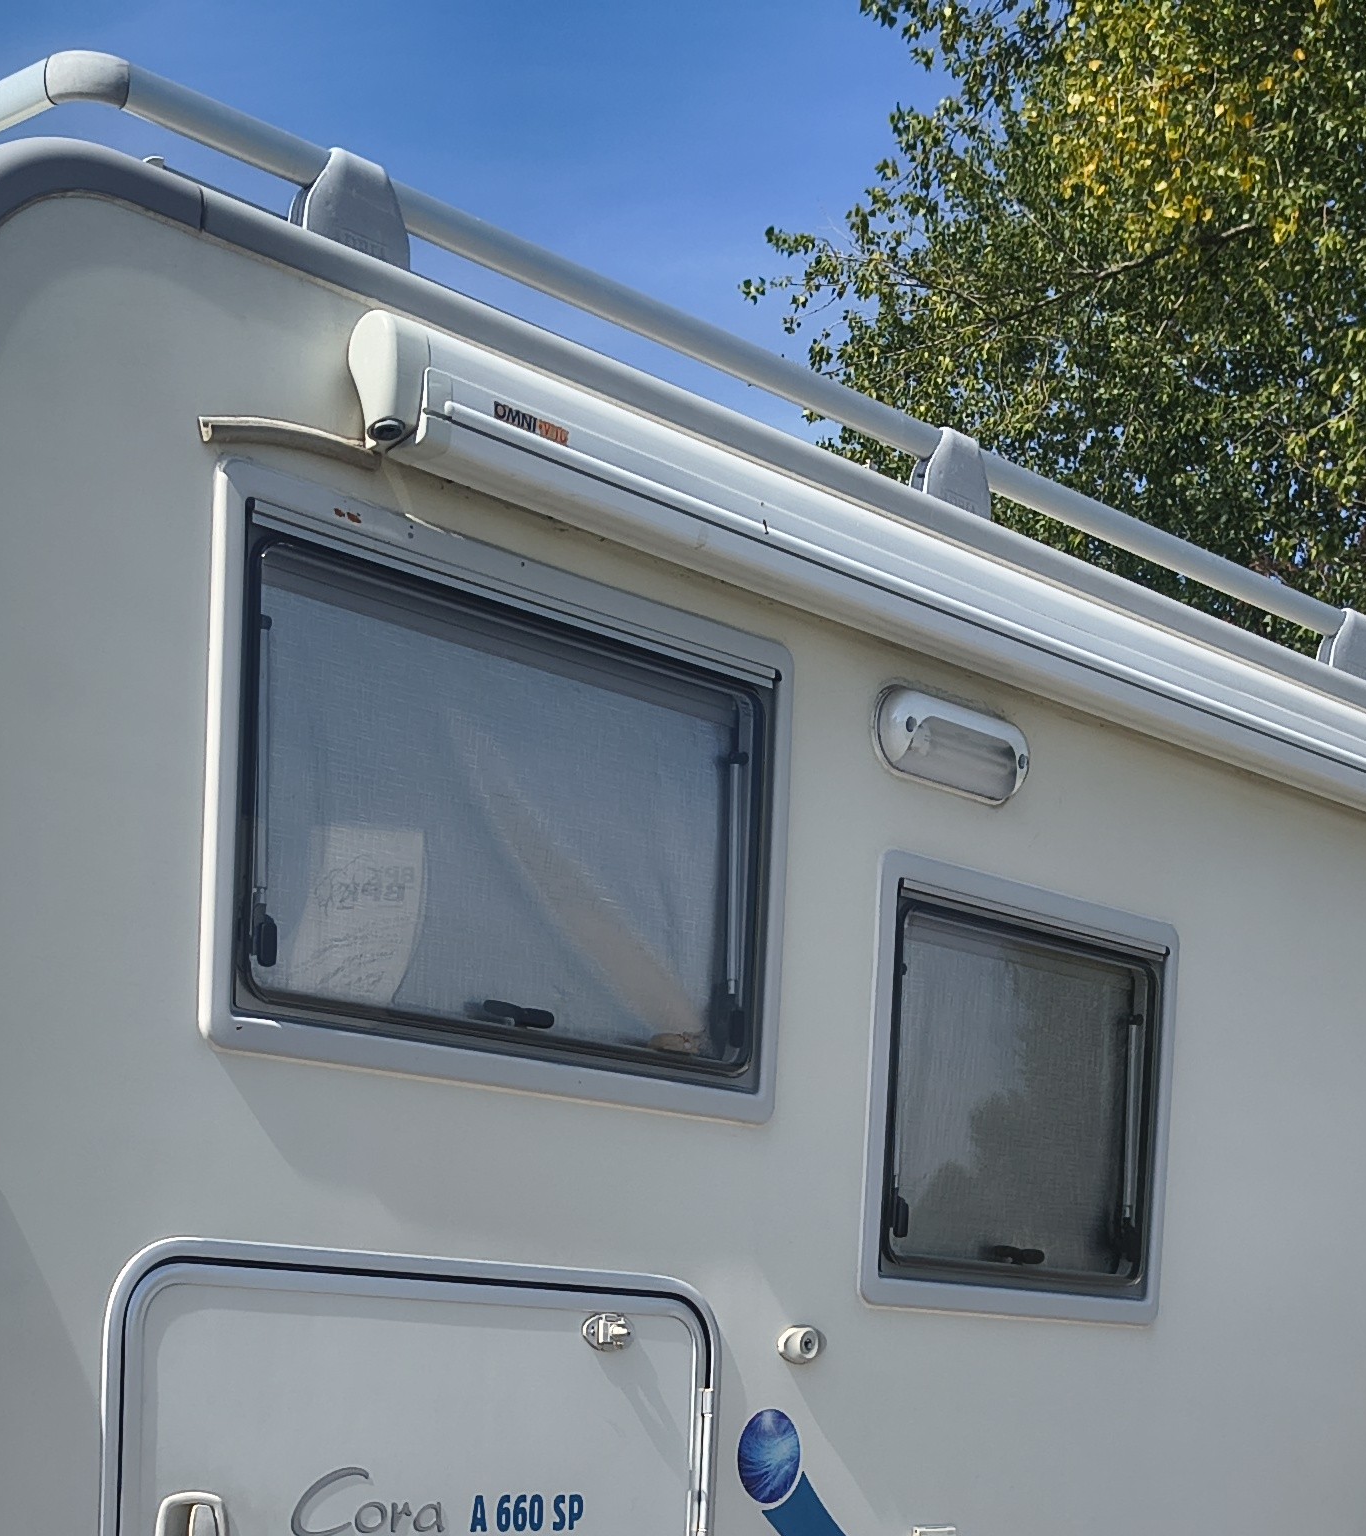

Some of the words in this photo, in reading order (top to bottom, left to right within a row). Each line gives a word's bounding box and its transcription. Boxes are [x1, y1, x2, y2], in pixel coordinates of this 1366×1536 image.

[469, 1494, 487, 1533] A
[496, 1493, 544, 1532] 660
[552, 1493, 584, 1532] SP
